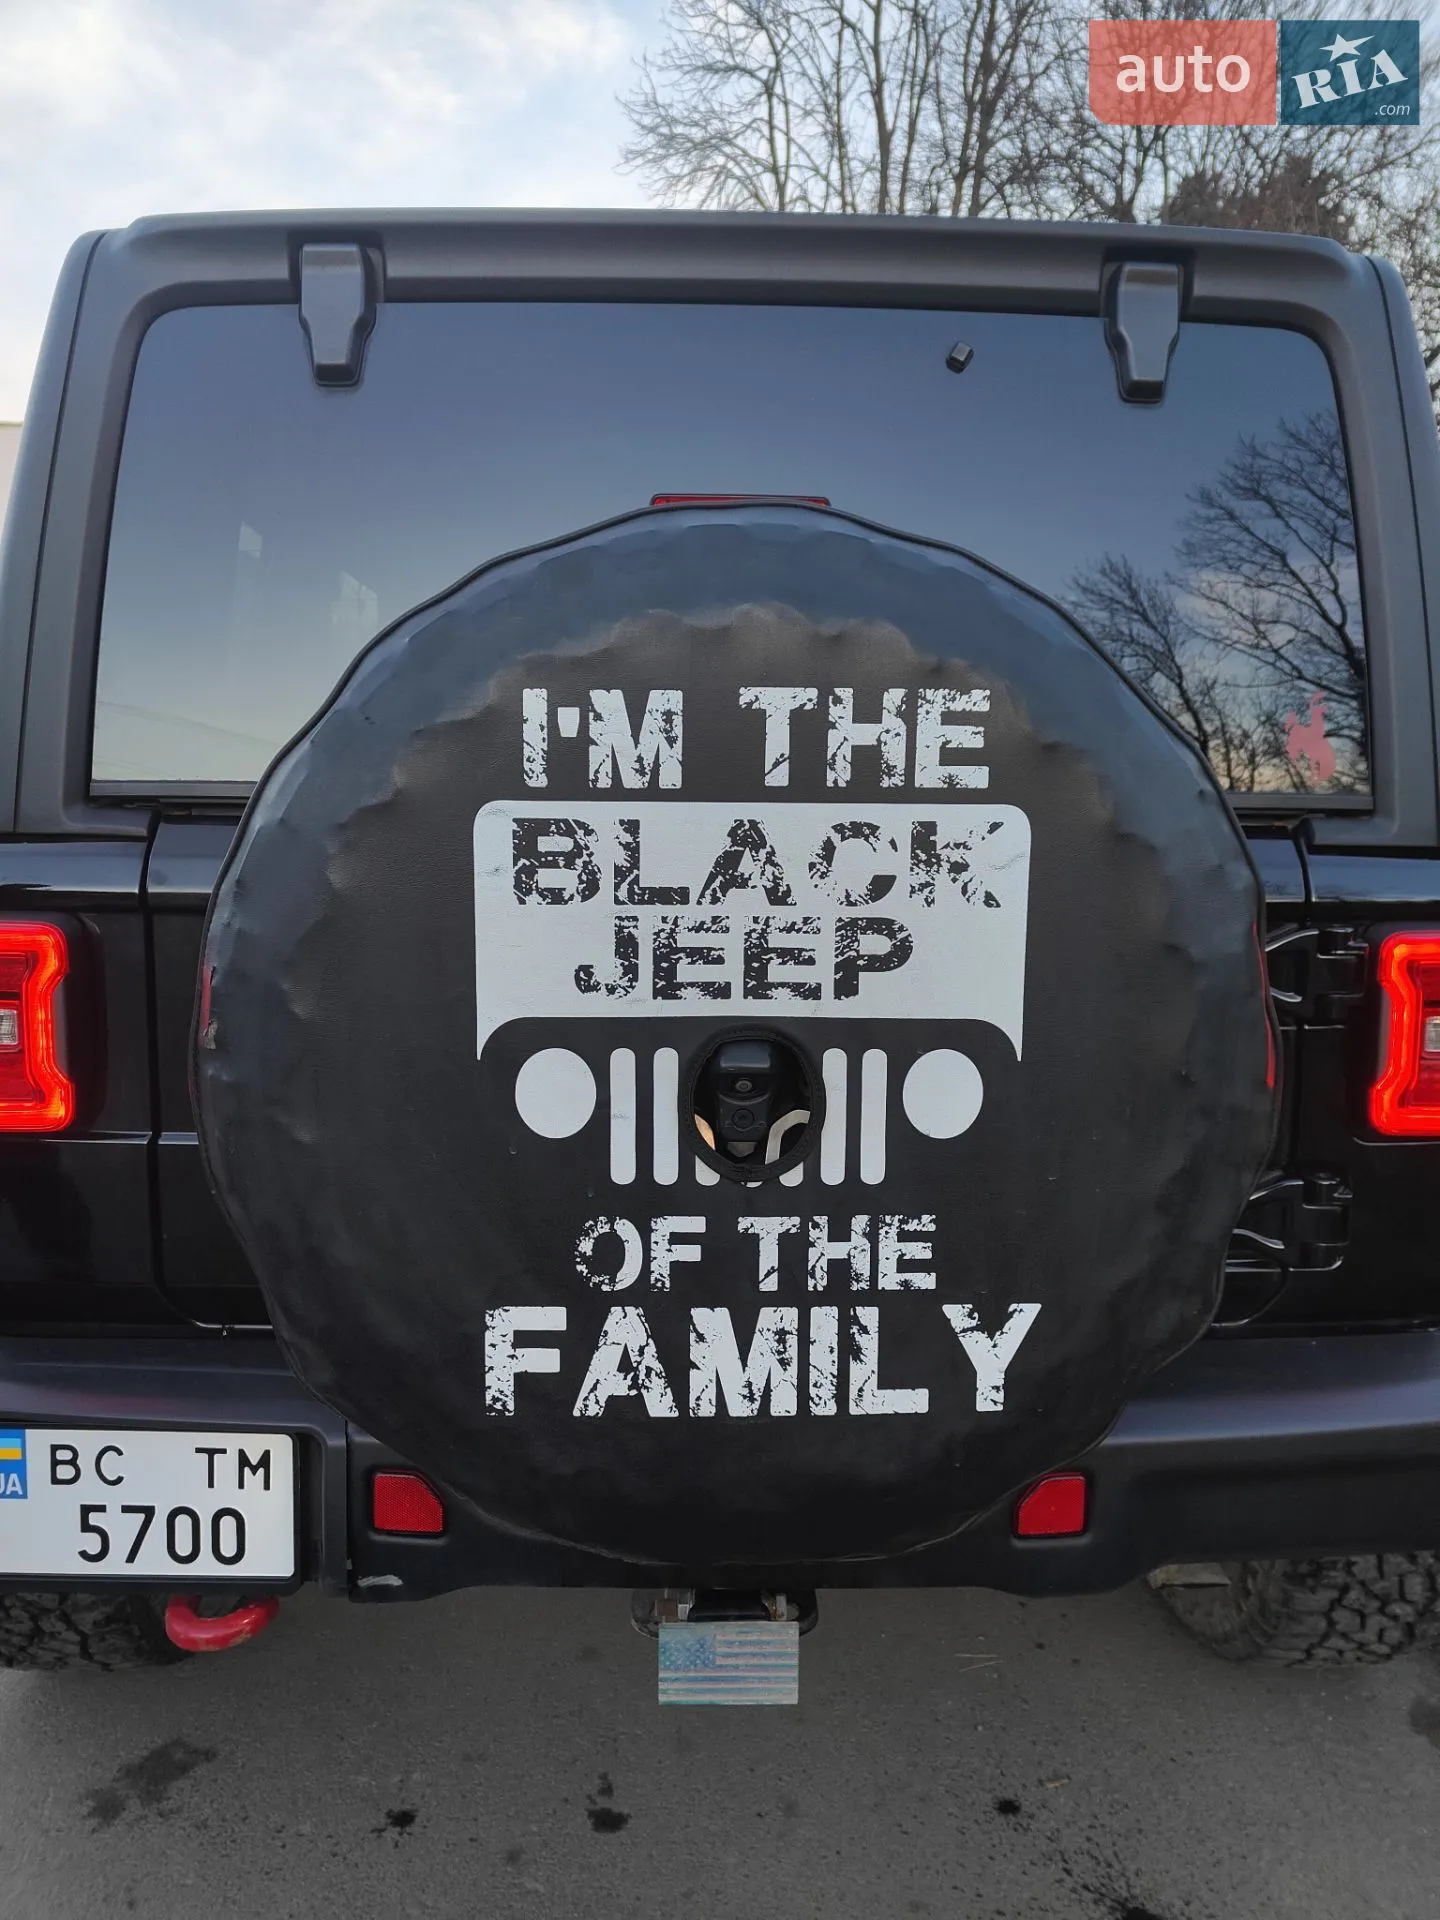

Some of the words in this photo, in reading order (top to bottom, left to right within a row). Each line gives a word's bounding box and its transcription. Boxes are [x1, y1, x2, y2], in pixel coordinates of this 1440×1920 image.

[522, 687, 684, 790] I'M
[738, 687, 991, 789] THE
[512, 817, 1004, 909] BLACK
[574, 914, 914, 1000] JEEP
[575, 1214, 706, 1293] OF
[737, 1213, 937, 1292] THE
[485, 1303, 1042, 1417] FAMILY
[50, 1444, 124, 1486] BC
[194, 1446, 271, 1491] TM
[77, 1503, 246, 1566] 5700
